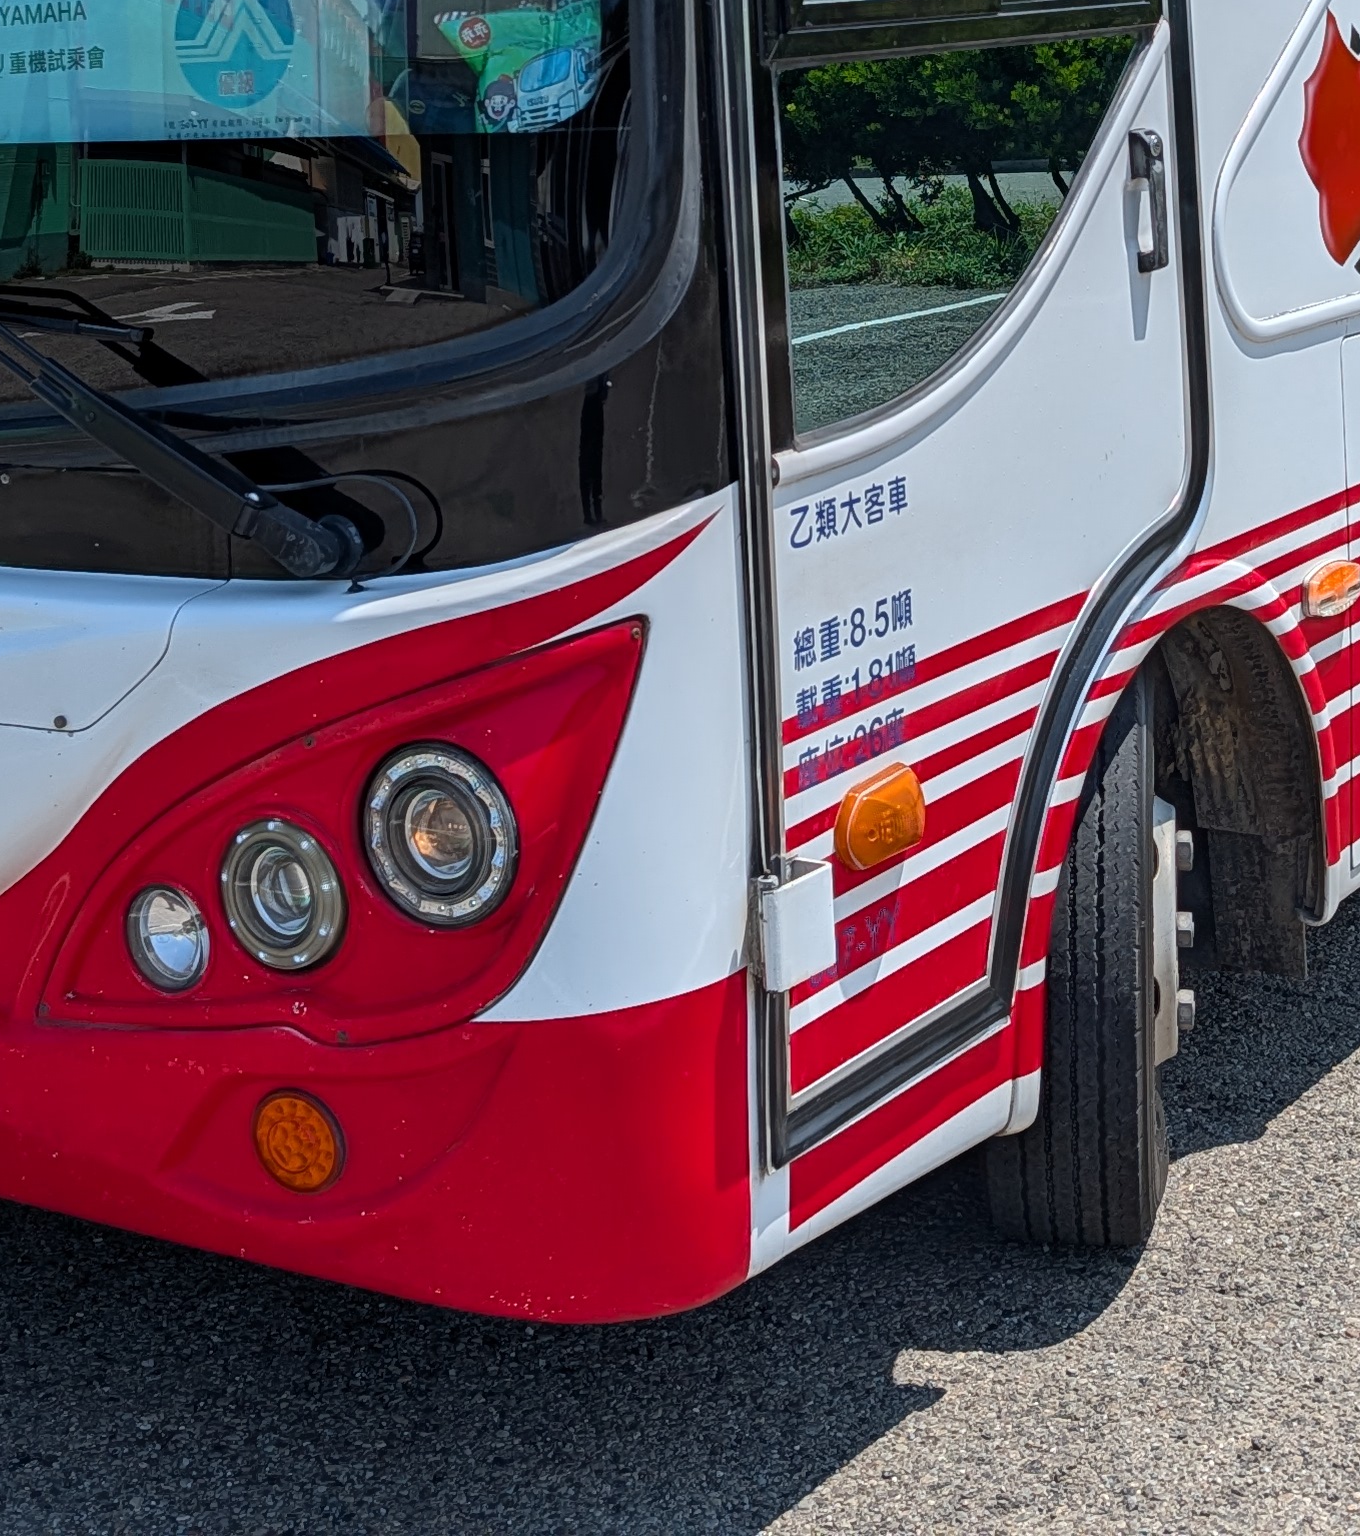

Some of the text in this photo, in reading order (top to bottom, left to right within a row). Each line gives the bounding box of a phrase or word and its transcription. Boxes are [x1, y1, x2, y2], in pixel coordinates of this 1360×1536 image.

[0, 0, 88, 27] YAMAHA
[790, 475, 908, 549] 乙類大客車
